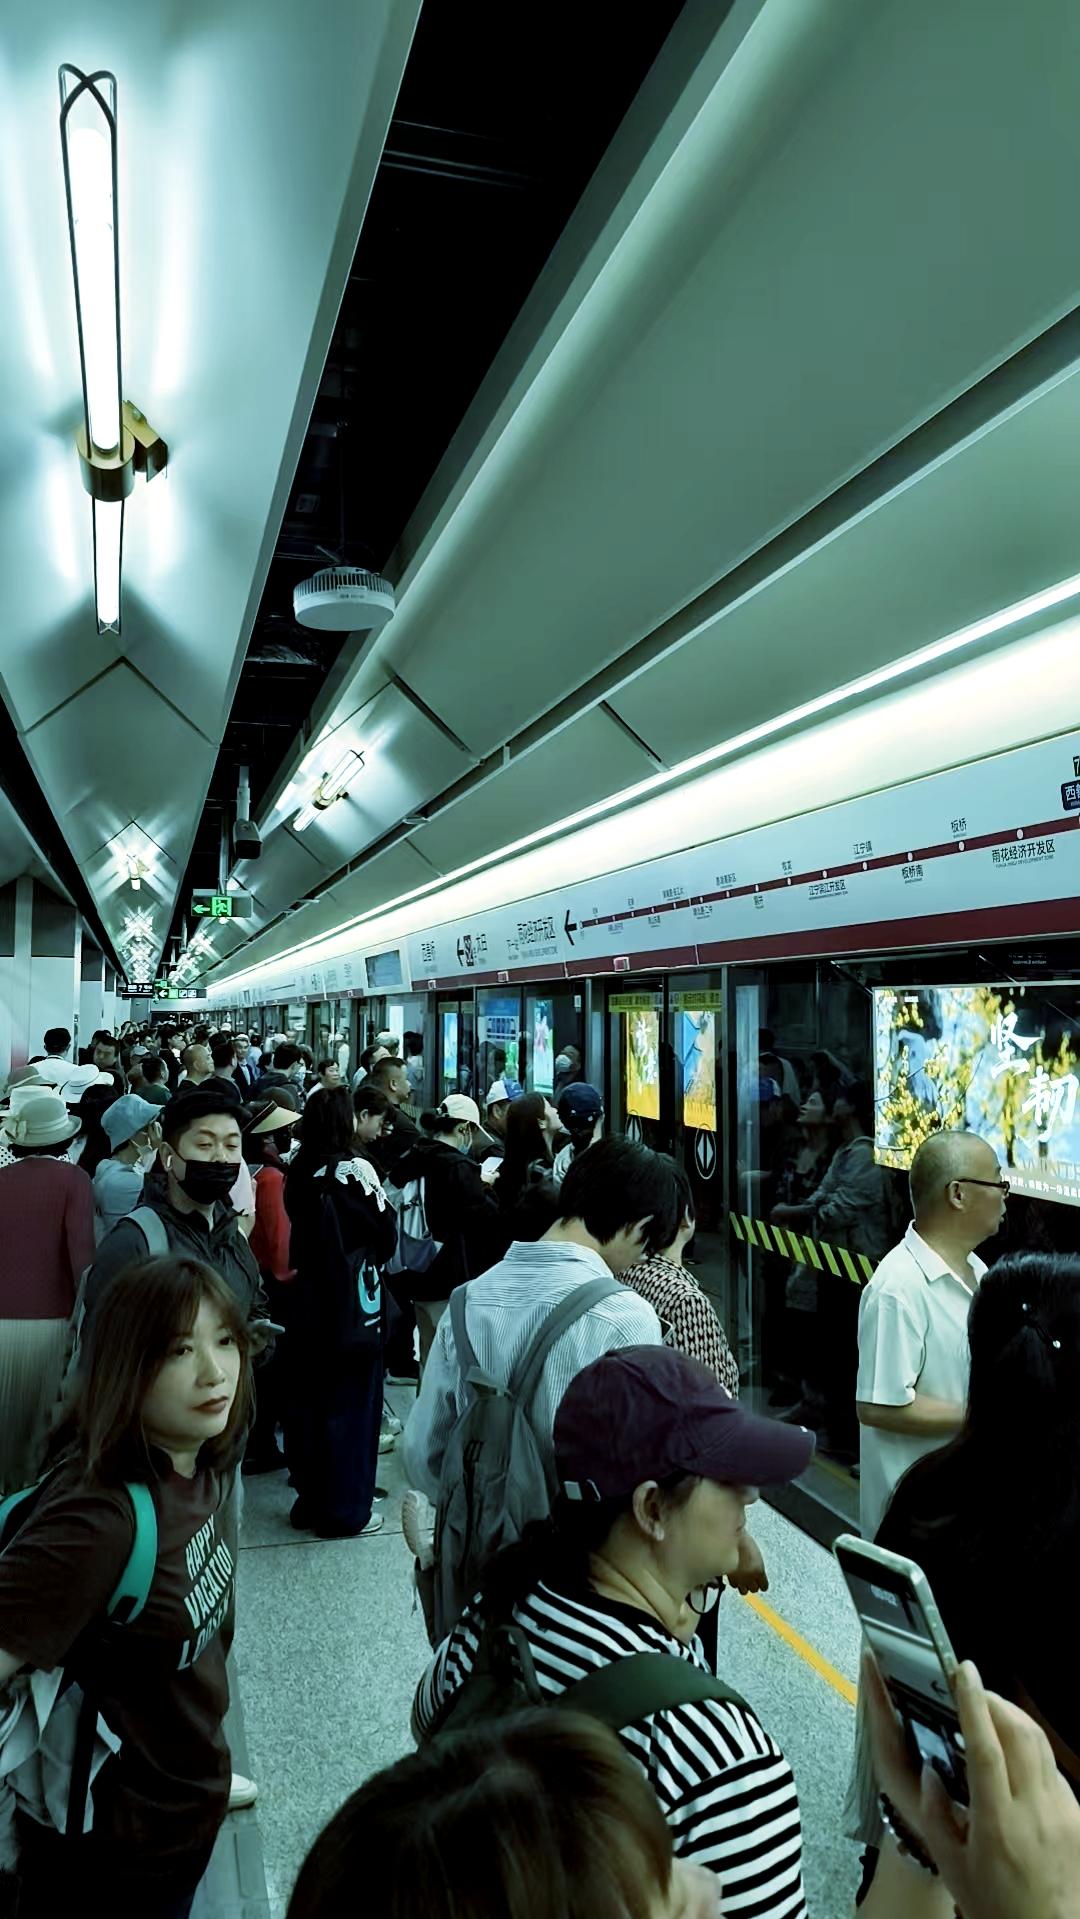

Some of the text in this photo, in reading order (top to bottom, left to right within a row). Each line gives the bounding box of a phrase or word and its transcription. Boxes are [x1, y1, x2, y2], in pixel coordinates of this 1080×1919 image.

[951, 818, 967, 833] 板桥
[992, 839, 1056, 863] 雨花经济开发区
[902, 864, 924, 879] 板桥南
[185, 1513, 215, 1581] HAPPY
